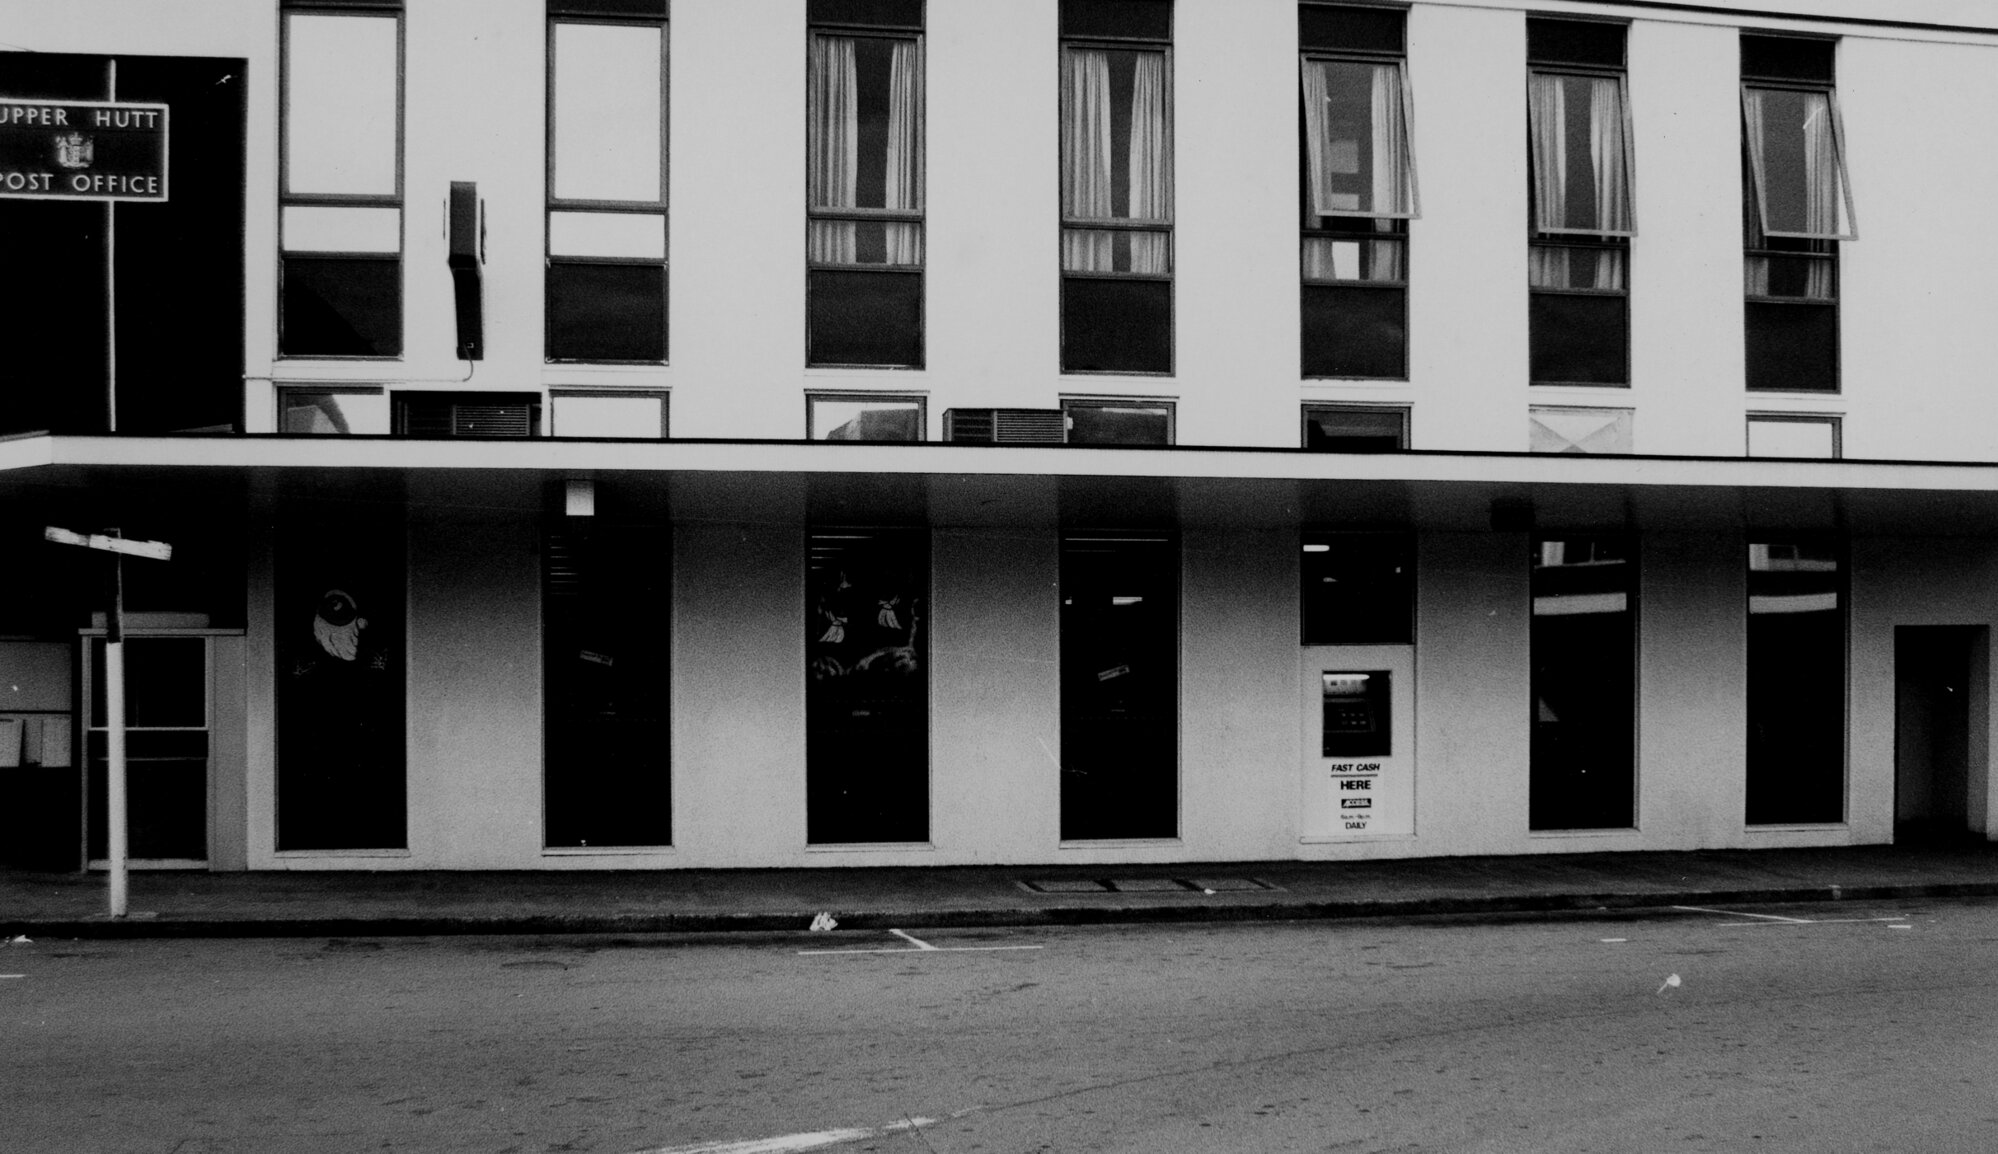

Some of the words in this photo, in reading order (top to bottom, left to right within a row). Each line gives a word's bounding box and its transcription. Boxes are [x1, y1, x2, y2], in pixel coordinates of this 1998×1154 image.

[0, 107, 69, 126] UPPER
[95, 110, 159, 129] HUTT
[72, 174, 158, 194] OFFICE
[1331, 763, 1354, 772] FAST
[1356, 763, 1381, 772] CASH
[1340, 780, 1372, 790] HERE
[1345, 821, 1367, 830] DAILY
